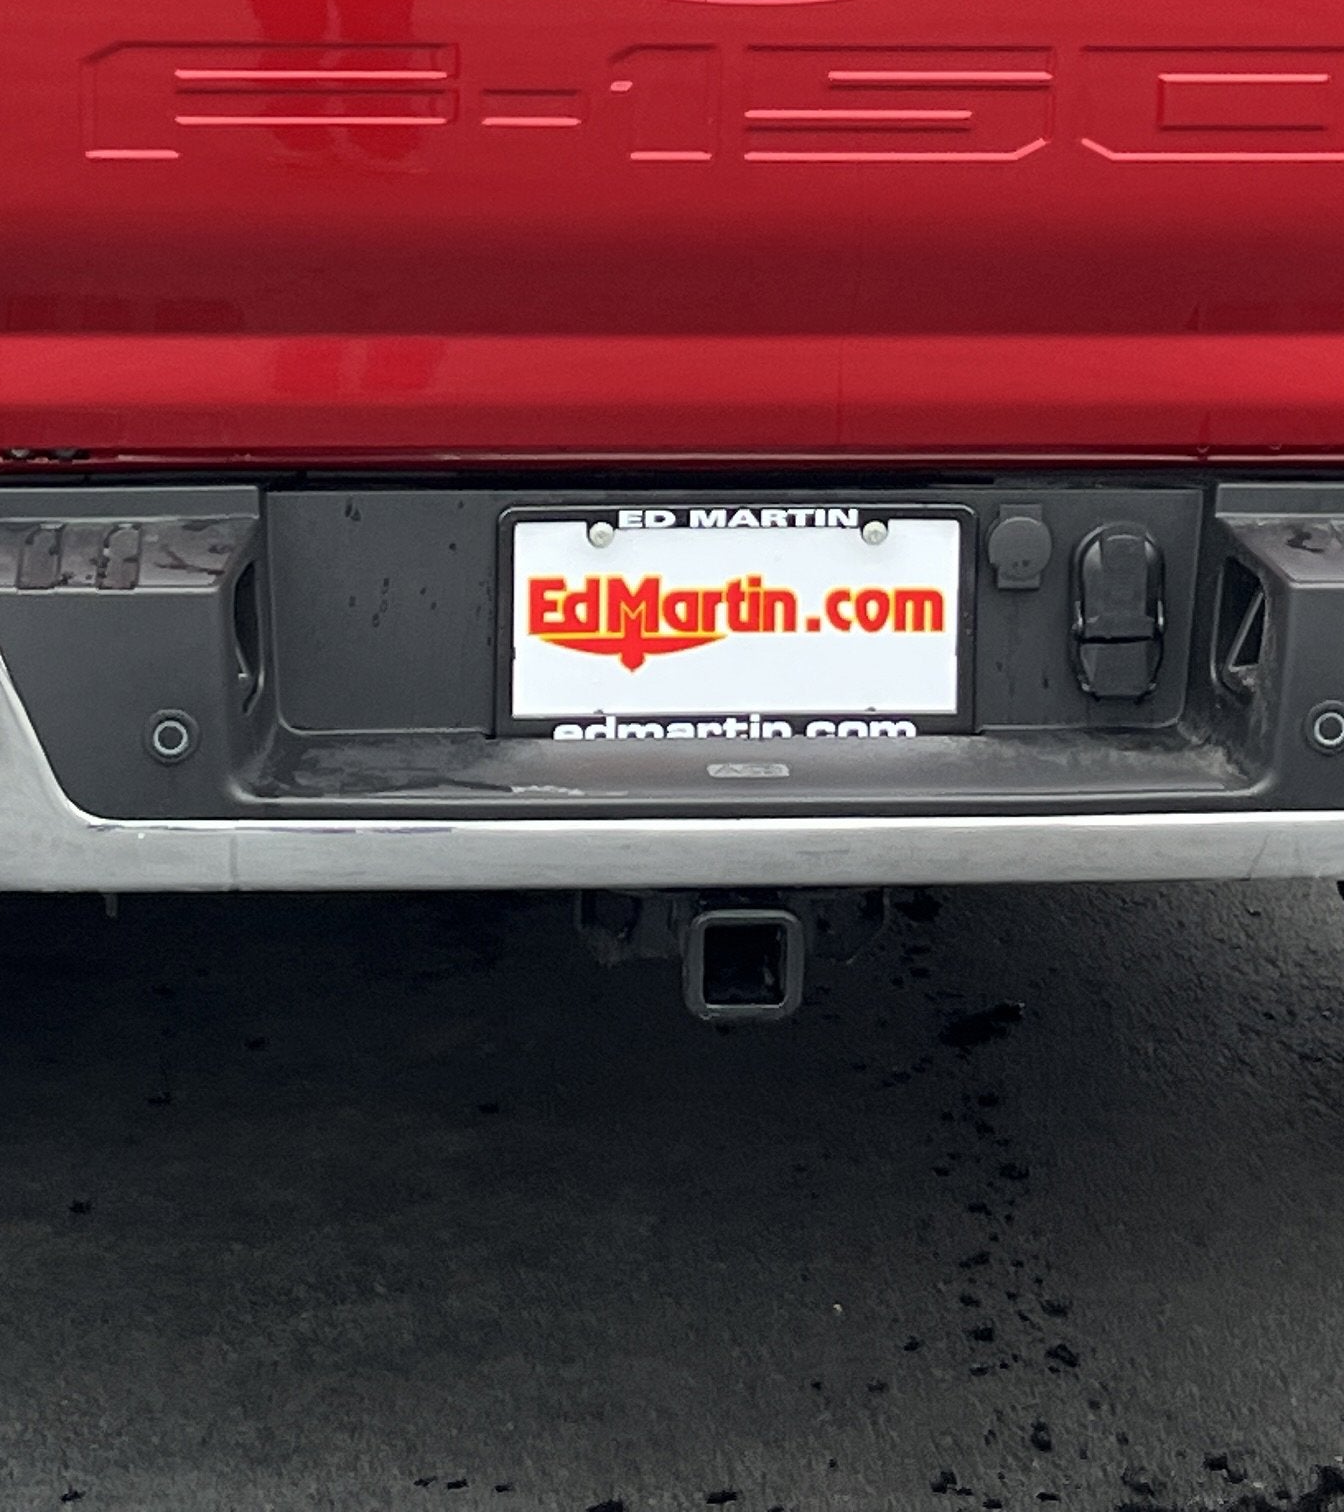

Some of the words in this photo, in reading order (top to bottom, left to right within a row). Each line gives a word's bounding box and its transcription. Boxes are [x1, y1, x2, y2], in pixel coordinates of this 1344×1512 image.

[617, 509, 677, 529] ED
[688, 507, 860, 529] MARTIN
[526, 575, 947, 637] EdMartin.com
[552, 713, 917, 740] edmartincom
